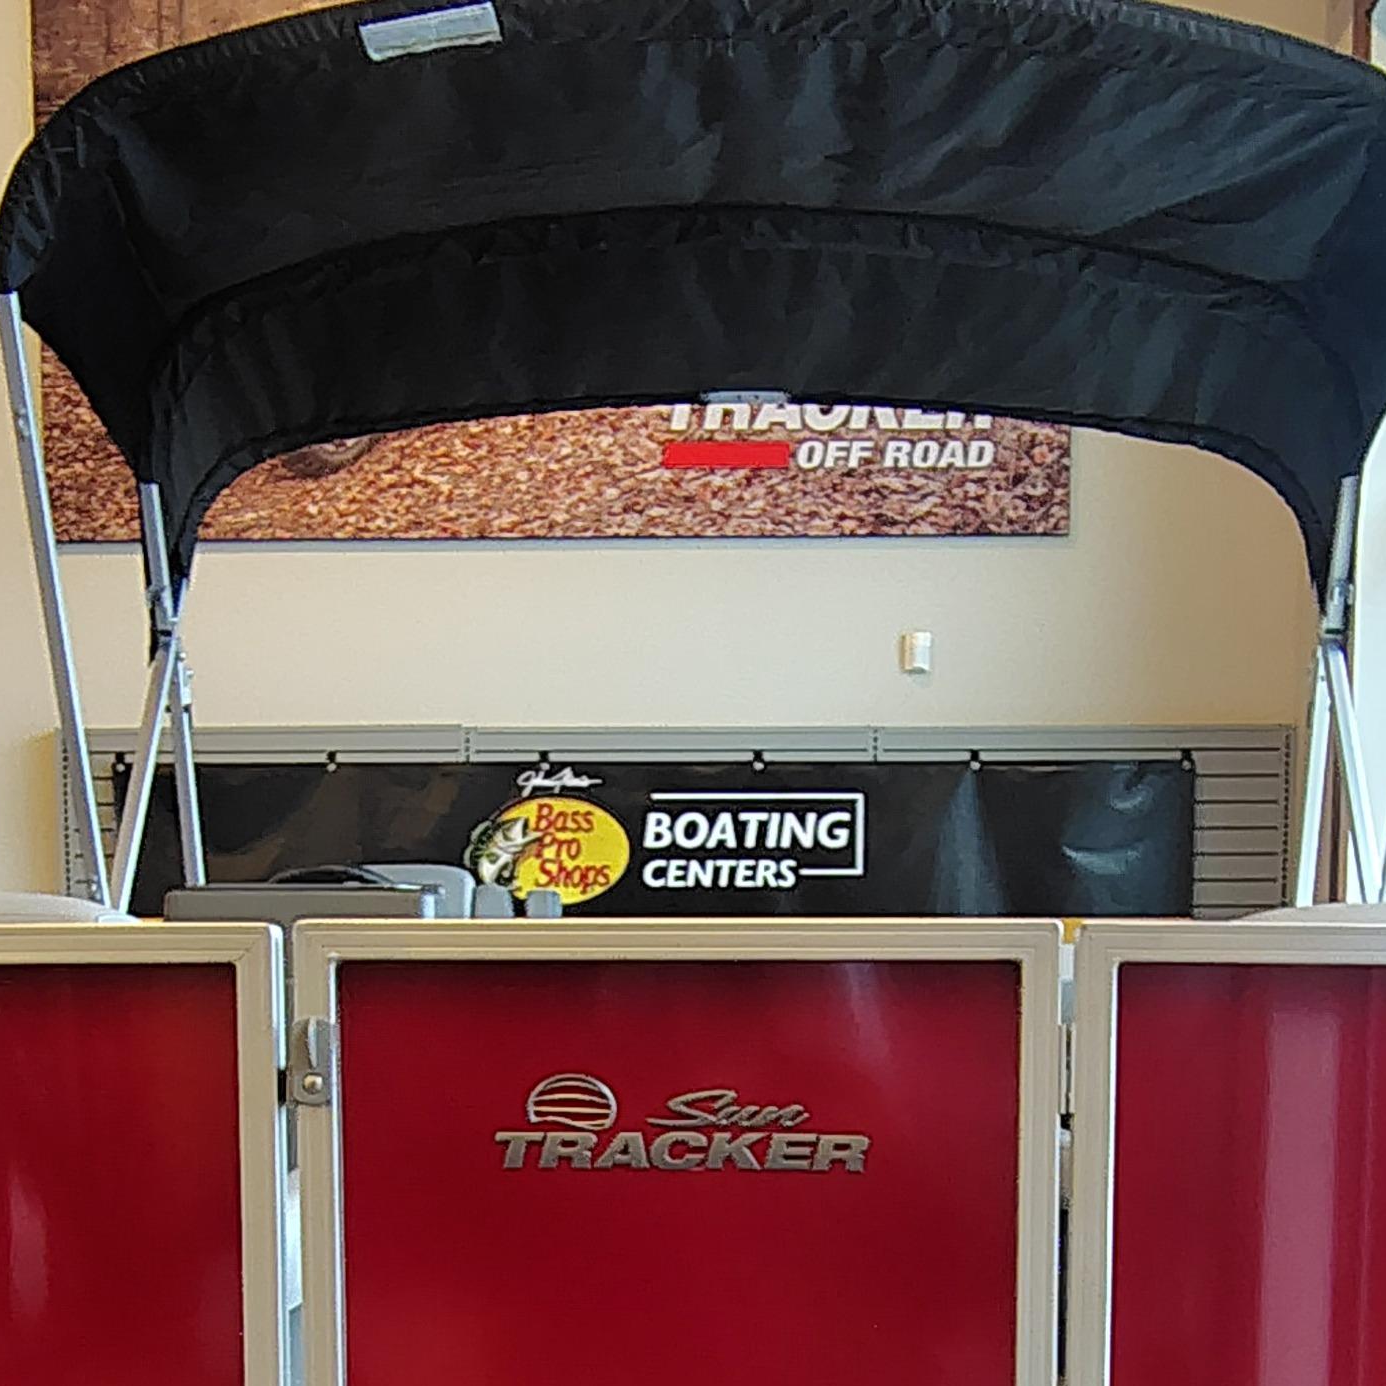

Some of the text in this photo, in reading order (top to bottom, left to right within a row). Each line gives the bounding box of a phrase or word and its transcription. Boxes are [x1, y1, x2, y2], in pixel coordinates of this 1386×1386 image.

[796, 440, 995, 469] OFF ROAD
[533, 803, 594, 832] Bass
[643, 811, 851, 850] BOATING
[534, 832, 581, 860] Pro
[535, 859, 611, 894] Shops
[642, 859, 797, 888] CENTERS
[646, 1089, 810, 1128] Sun
[495, 1131, 871, 1172] TRACKER
